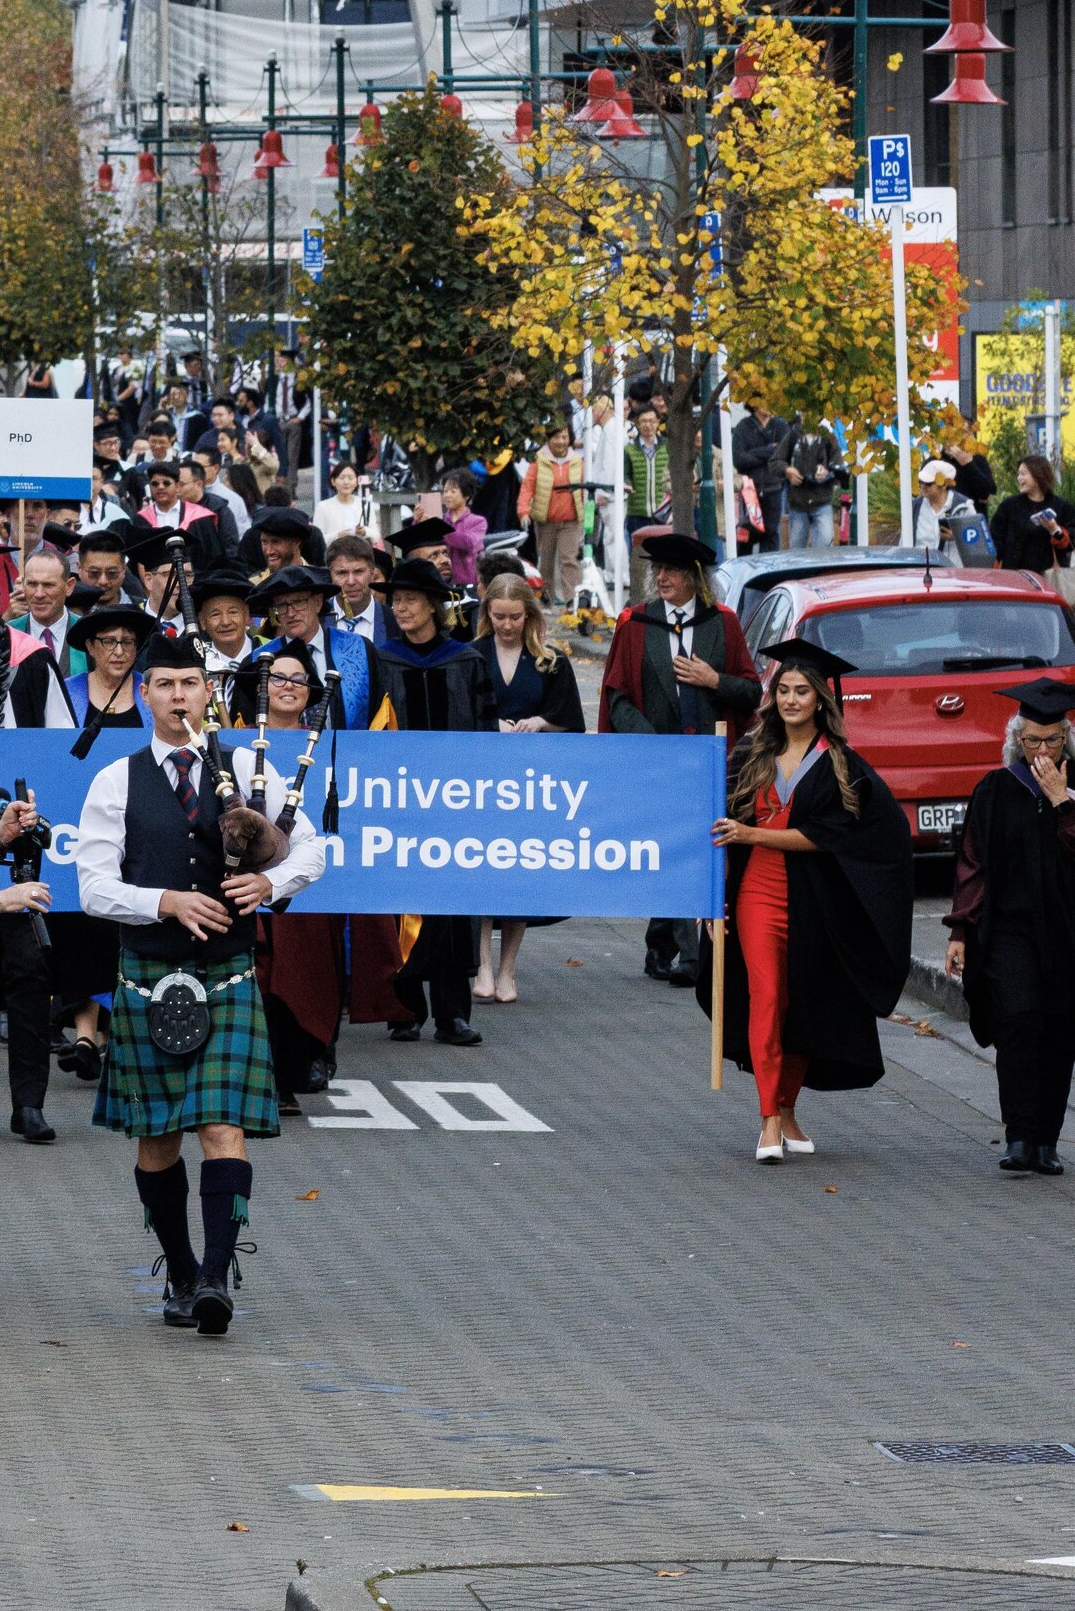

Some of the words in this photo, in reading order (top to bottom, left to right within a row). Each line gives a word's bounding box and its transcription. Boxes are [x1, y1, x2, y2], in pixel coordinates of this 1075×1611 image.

[880, 161, 900, 177] 120
[875, 178, 889, 186] Mon
[894, 177, 907, 185] Sun
[871, 208, 943, 224] Wlson
[8, 433, 34, 444] PhD
[966, 529, 977, 542] P
[325, 766, 589, 821] University
[361, 826, 661, 872] Procession
[308, 1079, 556, 1132] 30
